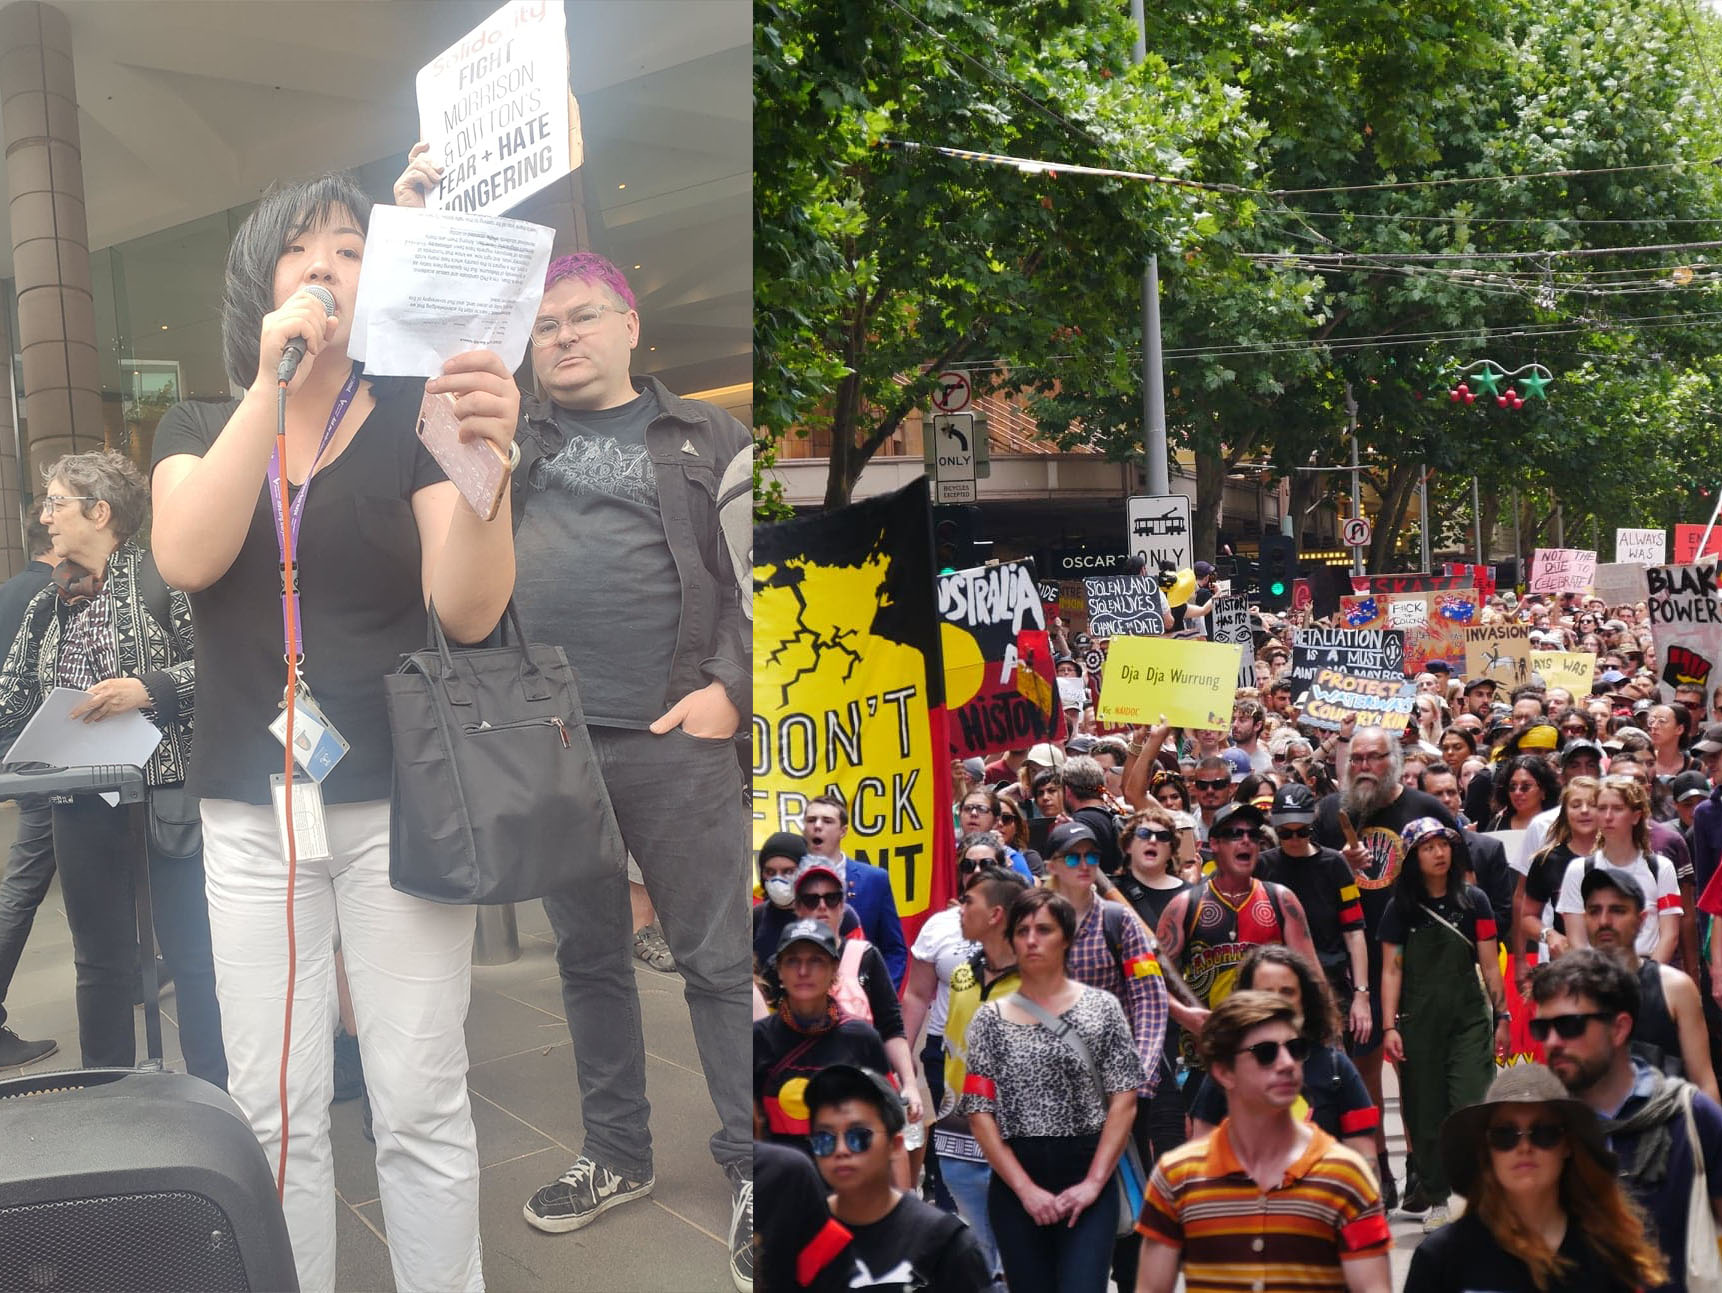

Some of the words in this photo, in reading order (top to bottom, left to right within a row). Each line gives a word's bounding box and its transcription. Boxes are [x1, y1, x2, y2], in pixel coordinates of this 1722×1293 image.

[459, 38, 514, 90] FIGHT
[444, 60, 534, 134] MORRISON
[457, 87, 541, 152] DUTTON'S
[438, 154, 477, 201] FEAR
[482, 150, 493, 162] +
[498, 112, 551, 161] HATE
[439, 146, 553, 212] ONGERING
[939, 455, 971, 467] ONLY
[1619, 532, 1664, 546] ALWAYS
[1062, 555, 1116, 568] OSCAR
[1542, 551, 1564, 560] NOT
[1574, 551, 1595, 560] THE
[1629, 549, 1653, 559] WAS
[1545, 562, 1568, 573] DATE
[1578, 563, 1590, 573] TO
[1085, 580, 1120, 597] STOLEN
[1120, 576, 1156, 596] LAND
[1647, 565, 1717, 597] BLAK
[1088, 598, 1120, 615] STOLEN
[1120, 595, 1155, 613] LIVES
[1649, 597, 1722, 625] POWER
[1092, 620, 1123, 636] CHANGE
[1134, 618, 1160, 635] DATE
[1216, 615, 1233, 628] HAS
[1293, 629, 1384, 649] RETALIATION
[1466, 625, 1529, 642] INVASION
[1306, 649, 1318, 661] IS
[1327, 649, 1338, 662] A
[1347, 650, 1384, 666] MUST
[1563, 658, 1588, 676] WAS
[1121, 665, 1139, 684] Dja
[1146, 667, 1165, 686] Dja
[1170, 668, 1221, 691] Wurrung
[1317, 670, 1403, 697] PROTECT
[1381, 712, 1411, 730] KIN
[753, 768, 923, 837] FRCK
